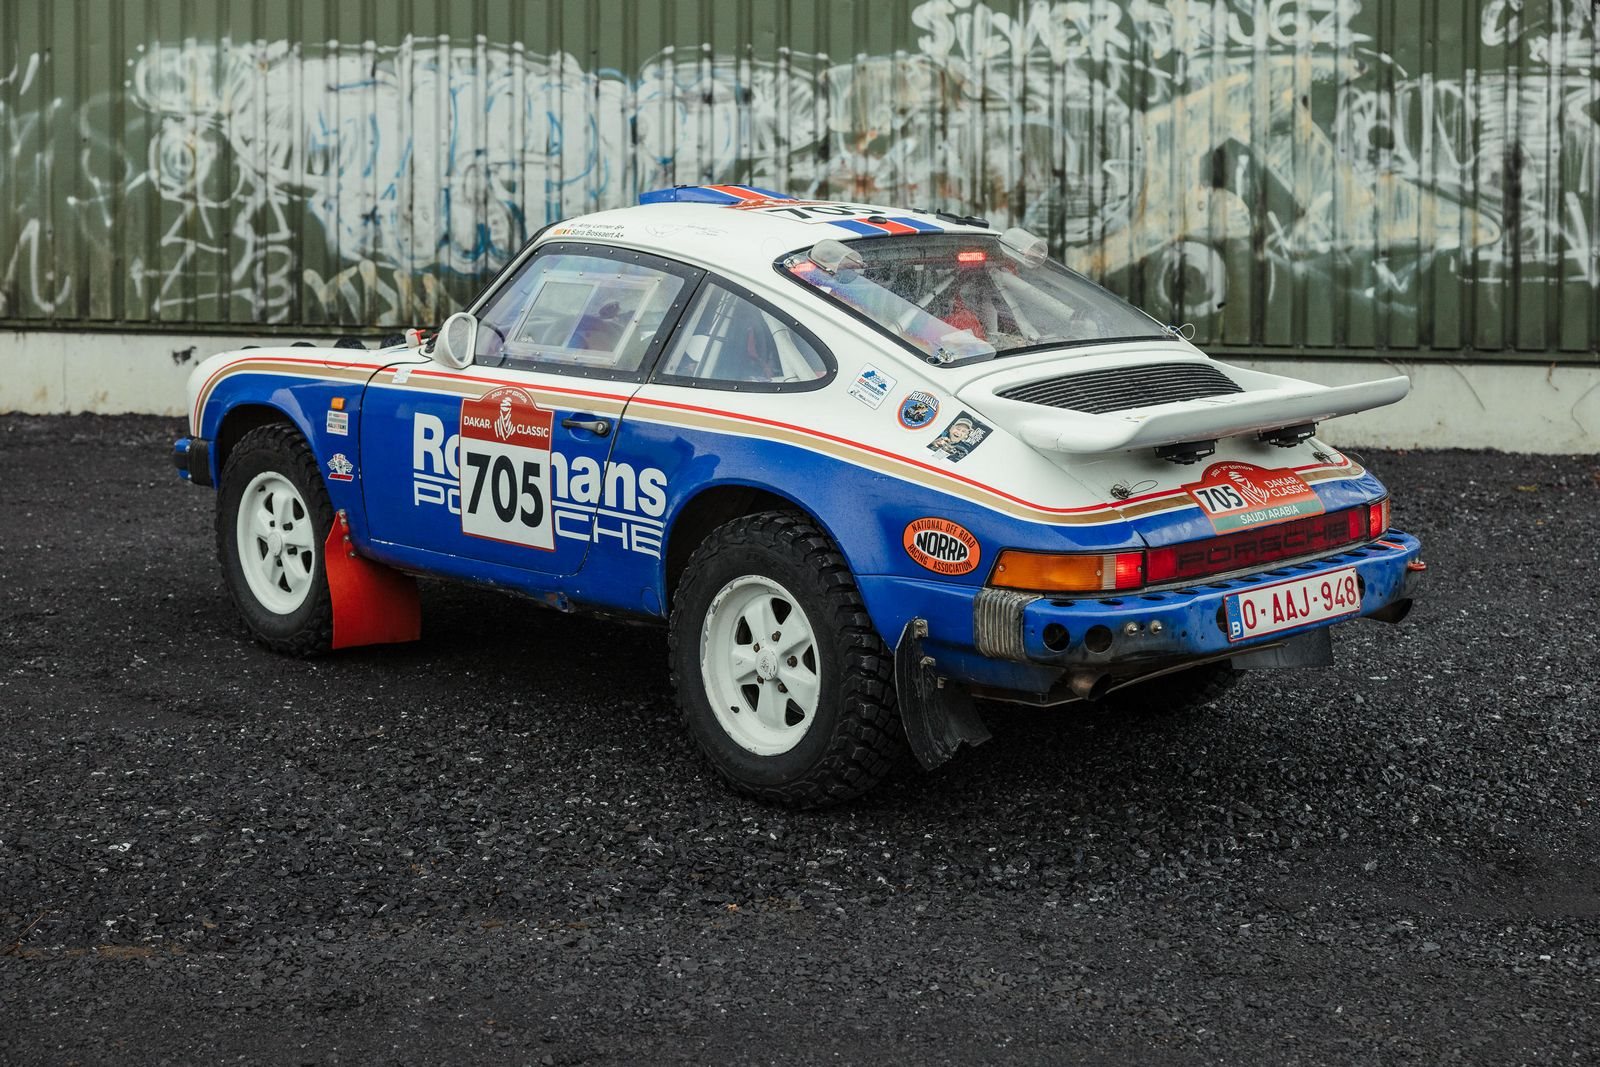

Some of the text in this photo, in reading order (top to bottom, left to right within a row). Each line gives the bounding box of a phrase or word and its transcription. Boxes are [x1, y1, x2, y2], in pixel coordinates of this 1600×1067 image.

[463, 415, 491, 430] DAKAR
[516, 423, 550, 438] CLASSIC
[466, 451, 544, 528] 705
[1264, 475, 1299, 489] DAKAR
[1270, 483, 1310, 498] CLASSIC
[1197, 485, 1244, 512] 705
[1239, 504, 1300, 525] SAUDI ARABIA
[912, 519, 976, 549] NATIONAL OFF ROAD
[1178, 519, 1349, 570] PORSCHE
[908, 543, 973, 573] RACING ASSOCIATION
[916, 531, 968, 562] NORRA
[1231, 621, 1242, 636] B
